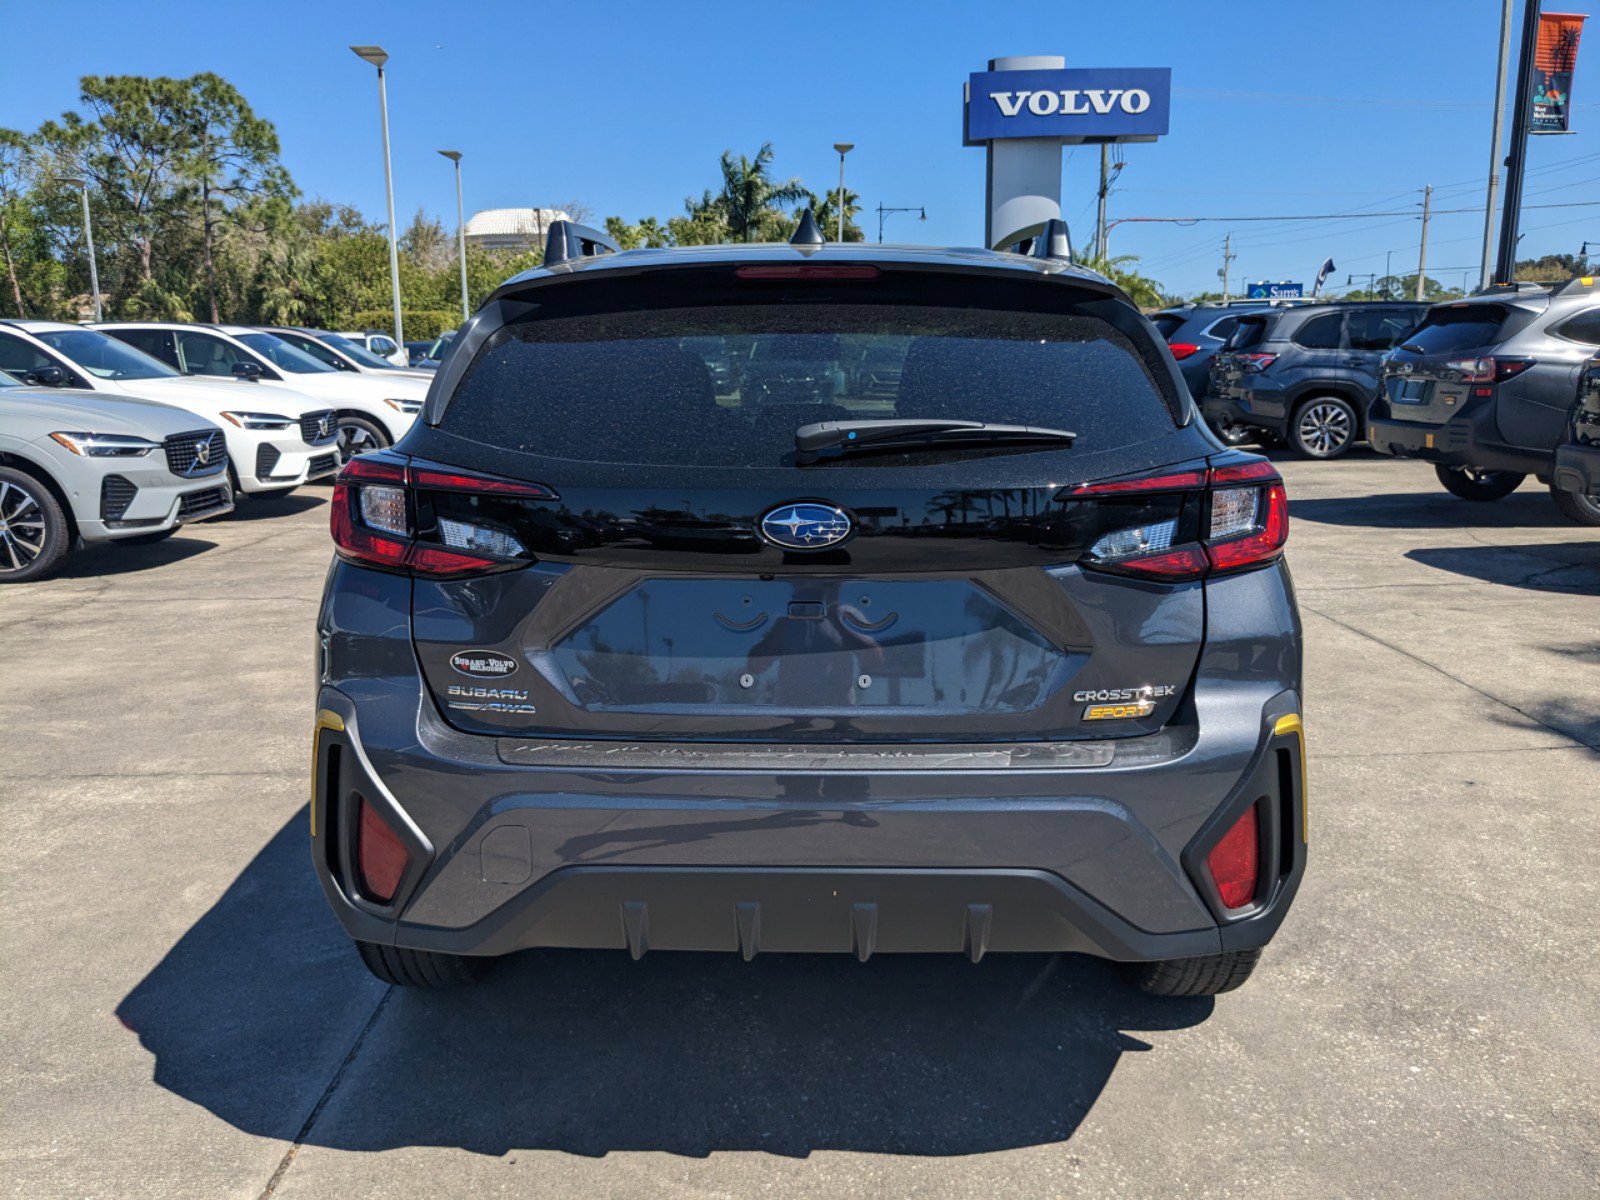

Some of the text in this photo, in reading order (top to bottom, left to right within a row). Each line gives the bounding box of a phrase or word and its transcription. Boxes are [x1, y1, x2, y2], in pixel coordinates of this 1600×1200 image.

[989, 88, 1151, 117] VOLVO
[1271, 286, 1300, 298] Sam's
[448, 686, 528, 700] SUBARU
[1073, 685, 1175, 701] CROSSTREK
[1089, 705, 1149, 718] SPORT
